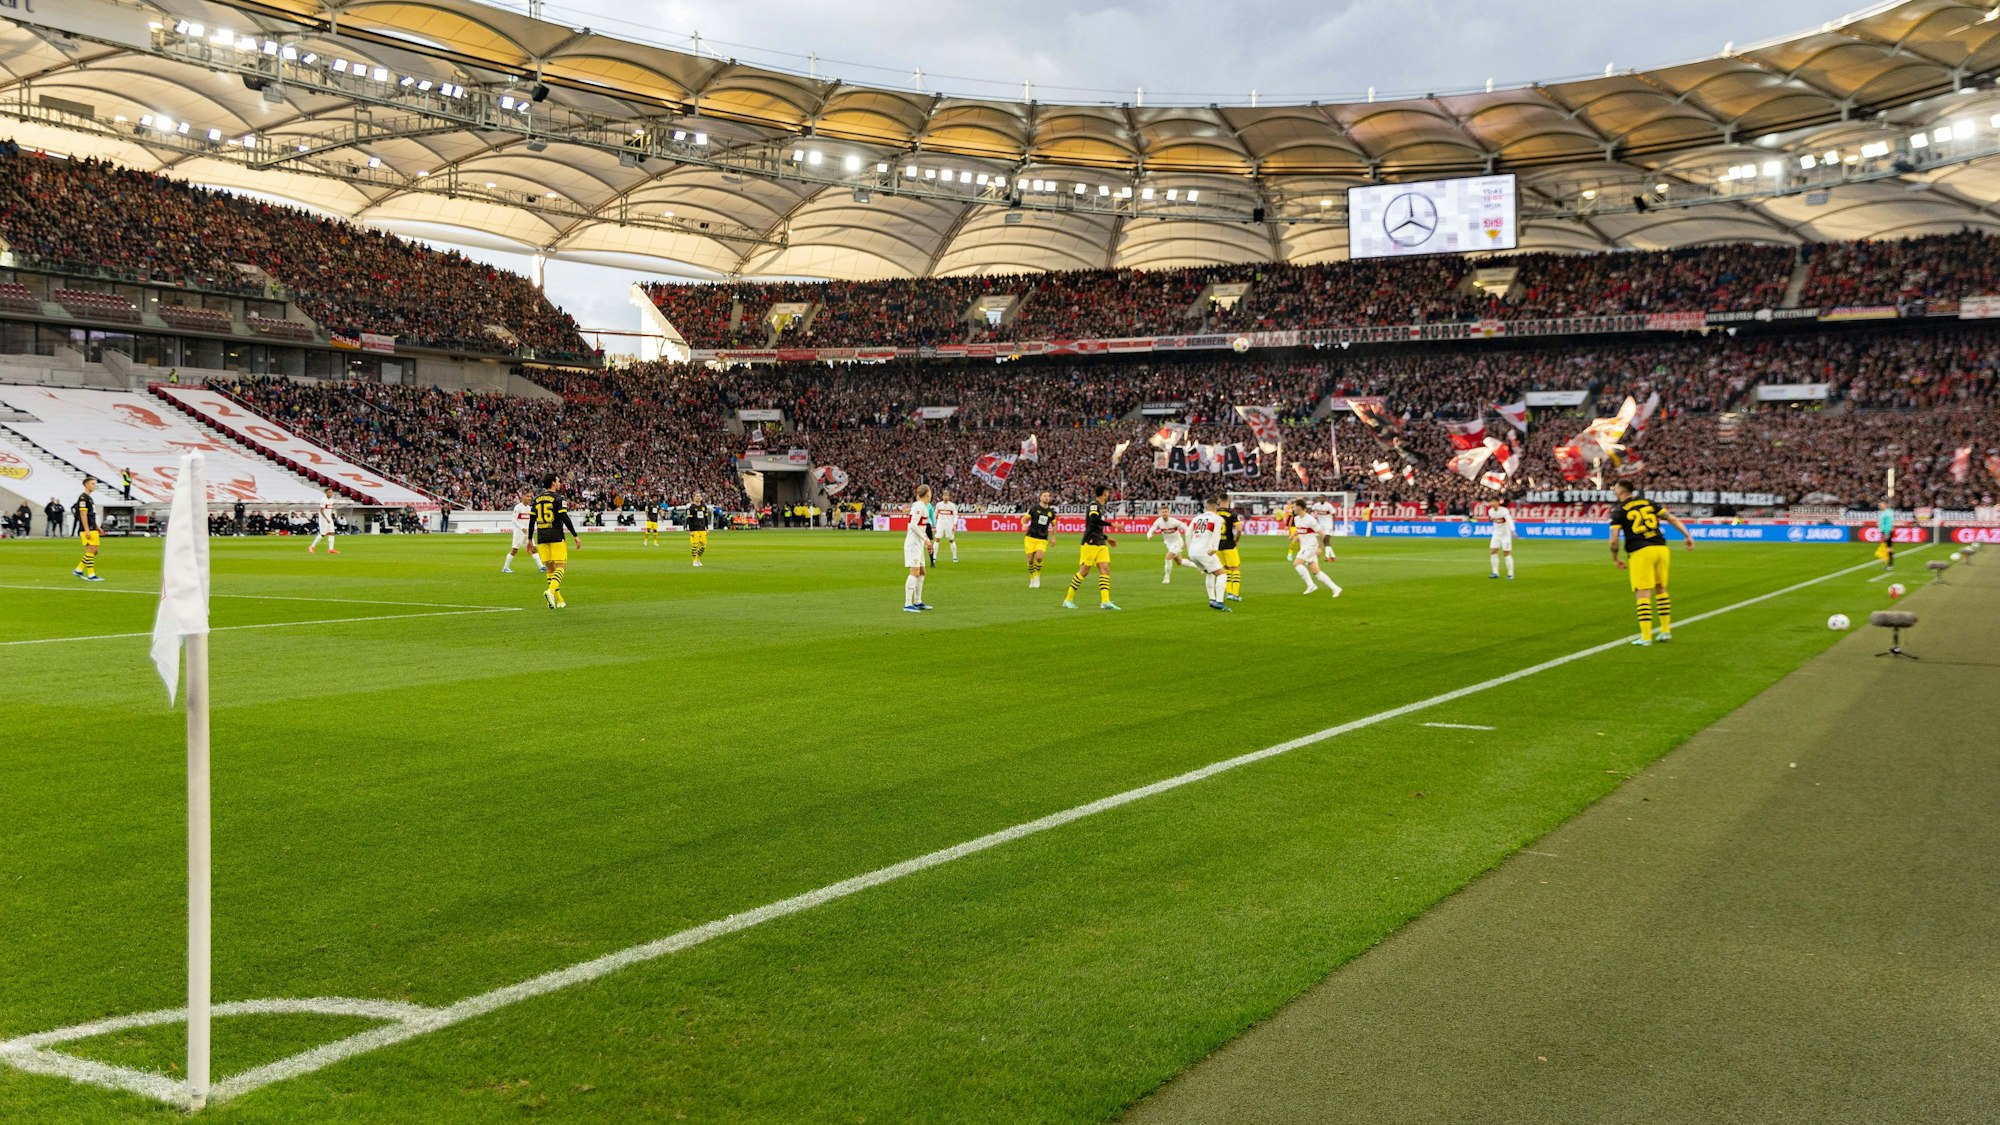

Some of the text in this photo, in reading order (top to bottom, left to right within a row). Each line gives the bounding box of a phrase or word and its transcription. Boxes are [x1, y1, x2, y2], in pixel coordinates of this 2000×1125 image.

[1420, 324, 1471, 339] KURVE
[1505, 315, 1646, 336] NECKARSTADION
[535, 502, 555, 523] 15
[991, 519, 1018, 531] Dein
[1194, 518, 1209, 534] 26
[1626, 505, 1658, 534] 25
[1375, 525, 1390, 534] WE
[1392, 525, 1409, 534] ARE
[1473, 526, 1494, 536] JAK
[1525, 527, 1541, 536] WE
[1542, 527, 1563, 536] ARE
[1688, 527, 1706, 538] WE
[1707, 528, 1729, 538] ARE
[1805, 528, 1843, 540] JAKO
[1864, 527, 1921, 543] GZI
